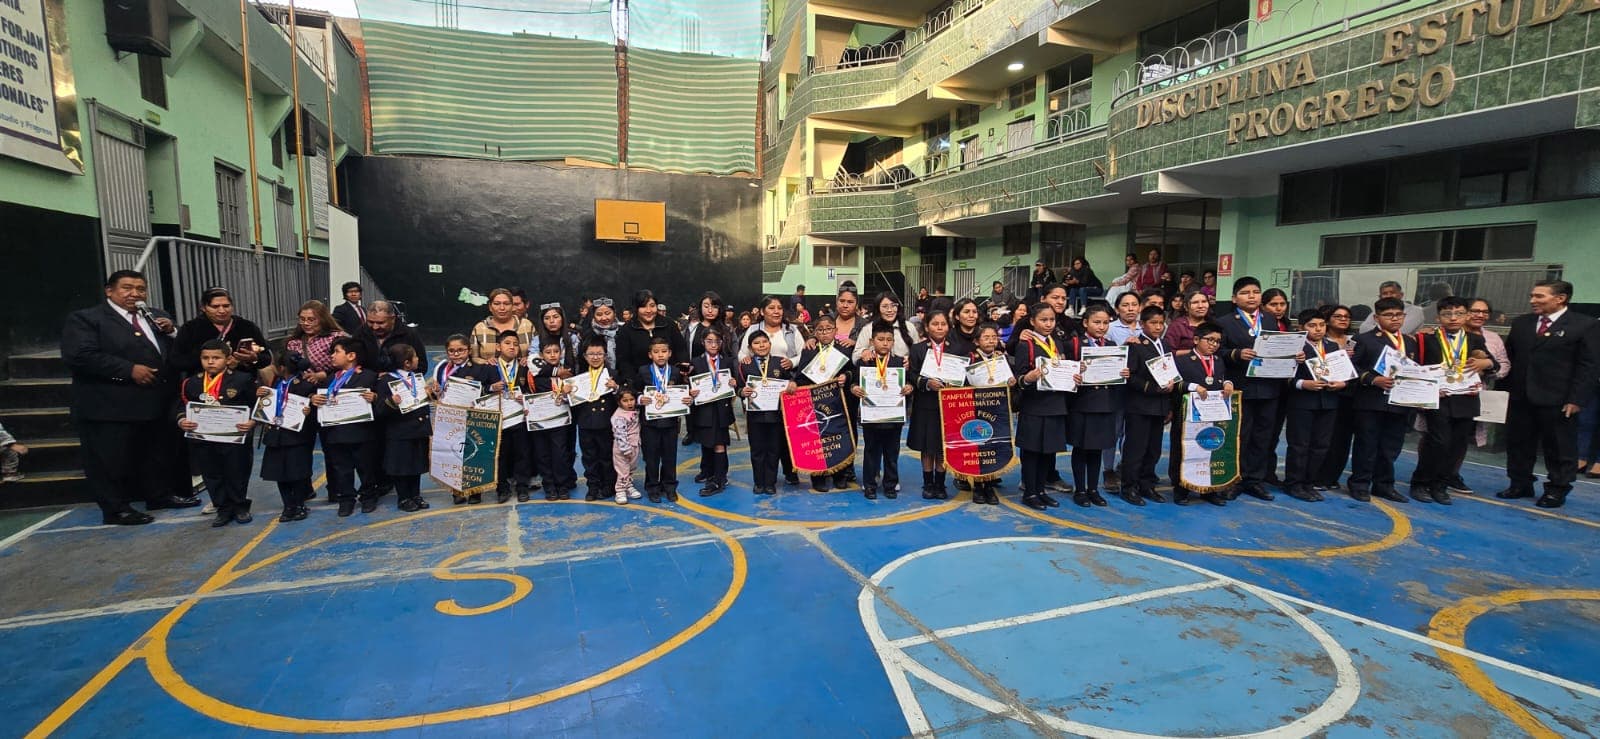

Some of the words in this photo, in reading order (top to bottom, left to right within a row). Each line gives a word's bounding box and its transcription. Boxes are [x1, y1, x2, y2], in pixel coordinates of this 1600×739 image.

[1, 16, 44, 53] FORJAN
[0, 39, 38, 70] TUROS
[0, 83, 49, 113] ONALES"
[1136, 52, 1316, 129] DISCIPLINA
[1227, 64, 1456, 144] PROGRESO
[942, 392, 973, 401] CAMPEÓN
[948, 401, 956, 409] DE
[958, 399, 1001, 408] MATEMÁTICA
[471, 411, 498, 420] ESCOLAR
[813, 434, 842, 446] PUESTO
[971, 450, 997, 458] PUESTO
[452, 464, 485, 475] PUESTO
[432, 545, 534, 616] S
